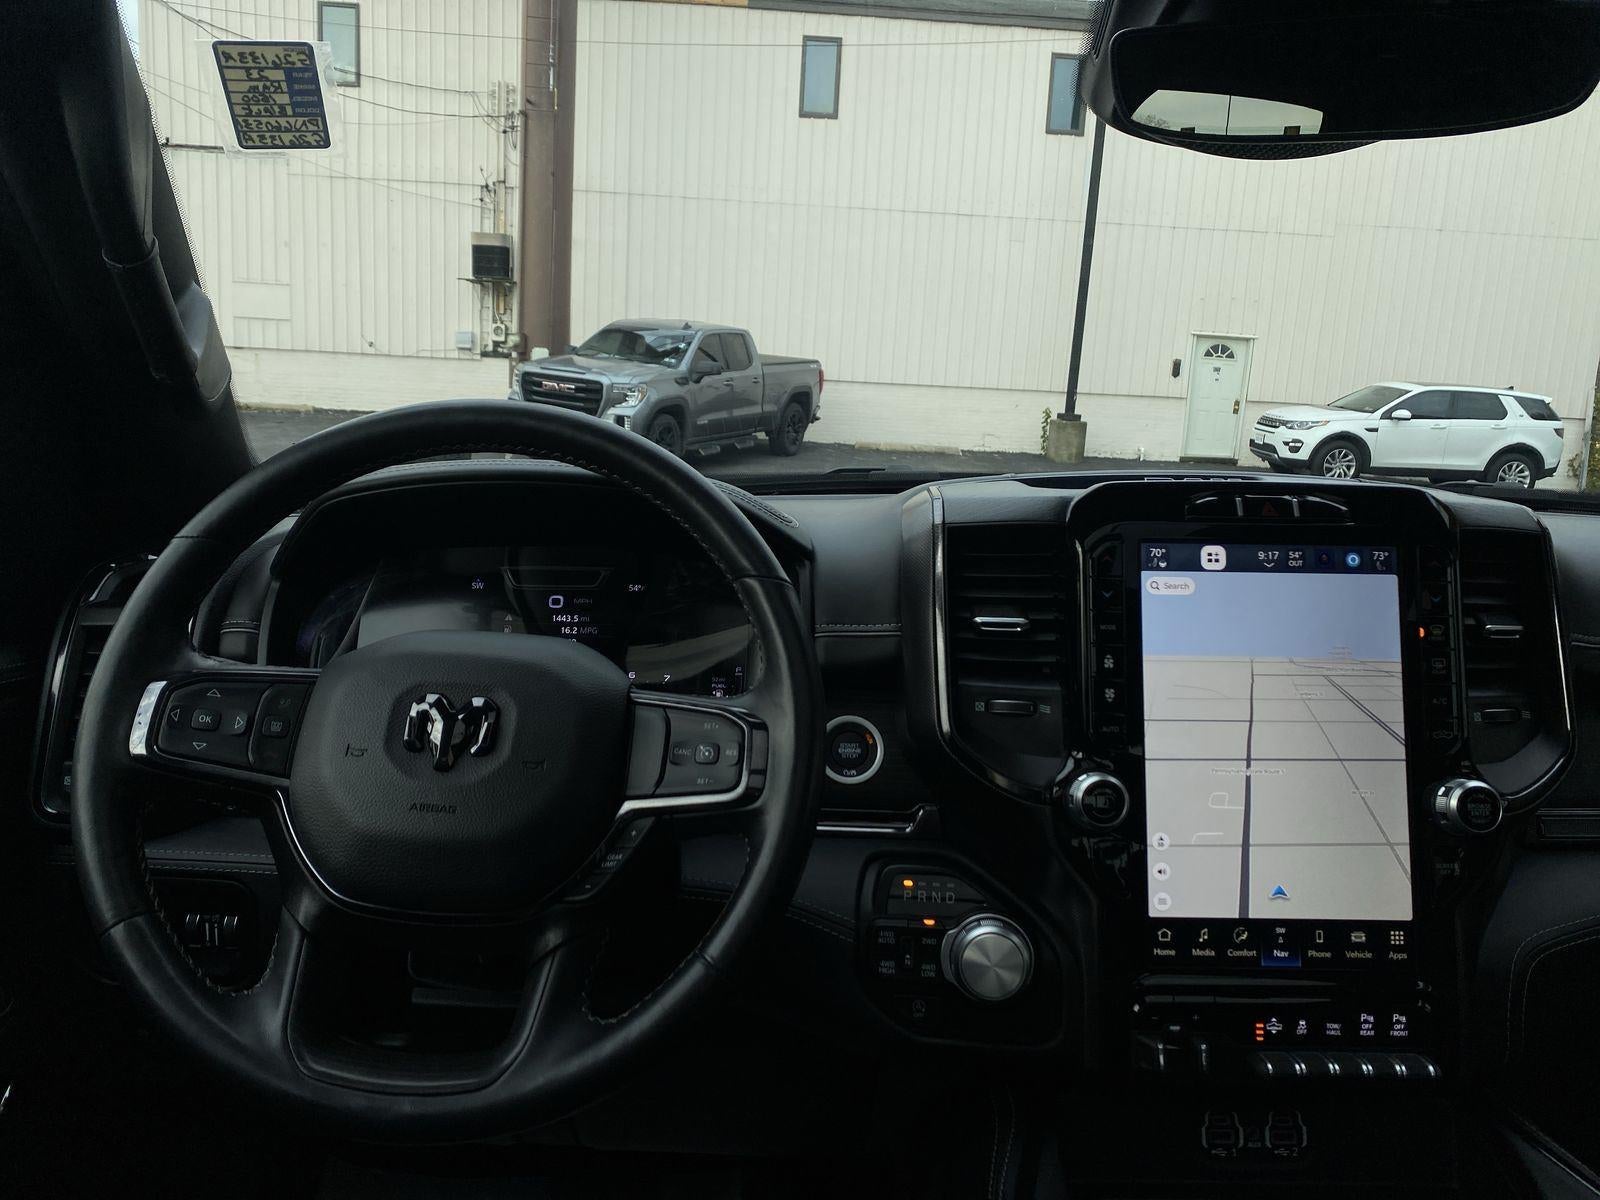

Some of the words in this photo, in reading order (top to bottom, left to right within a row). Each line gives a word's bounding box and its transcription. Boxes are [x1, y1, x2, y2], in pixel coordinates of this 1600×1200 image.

[1257, 550, 1279, 560] 9:17
[471, 582, 485, 590] SW
[1163, 581, 1190, 591] Search
[552, 614, 580, 623] 1443.5
[561, 626, 578, 635] 16.2
[580, 627, 599, 635] MPG
[663, 674, 671, 682] 7
[199, 714, 212, 723] OK
[1153, 948, 1177, 957] Home
[1191, 948, 1216, 957] Media
[1226, 948, 1258, 958] Comfort
[1273, 950, 1289, 958] Nav
[1308, 950, 1333, 959] Phone
[1344, 951, 1374, 960] Vehicle
[1388, 952, 1408, 962] Apps
[1393, 1023, 1405, 1031] OFF
